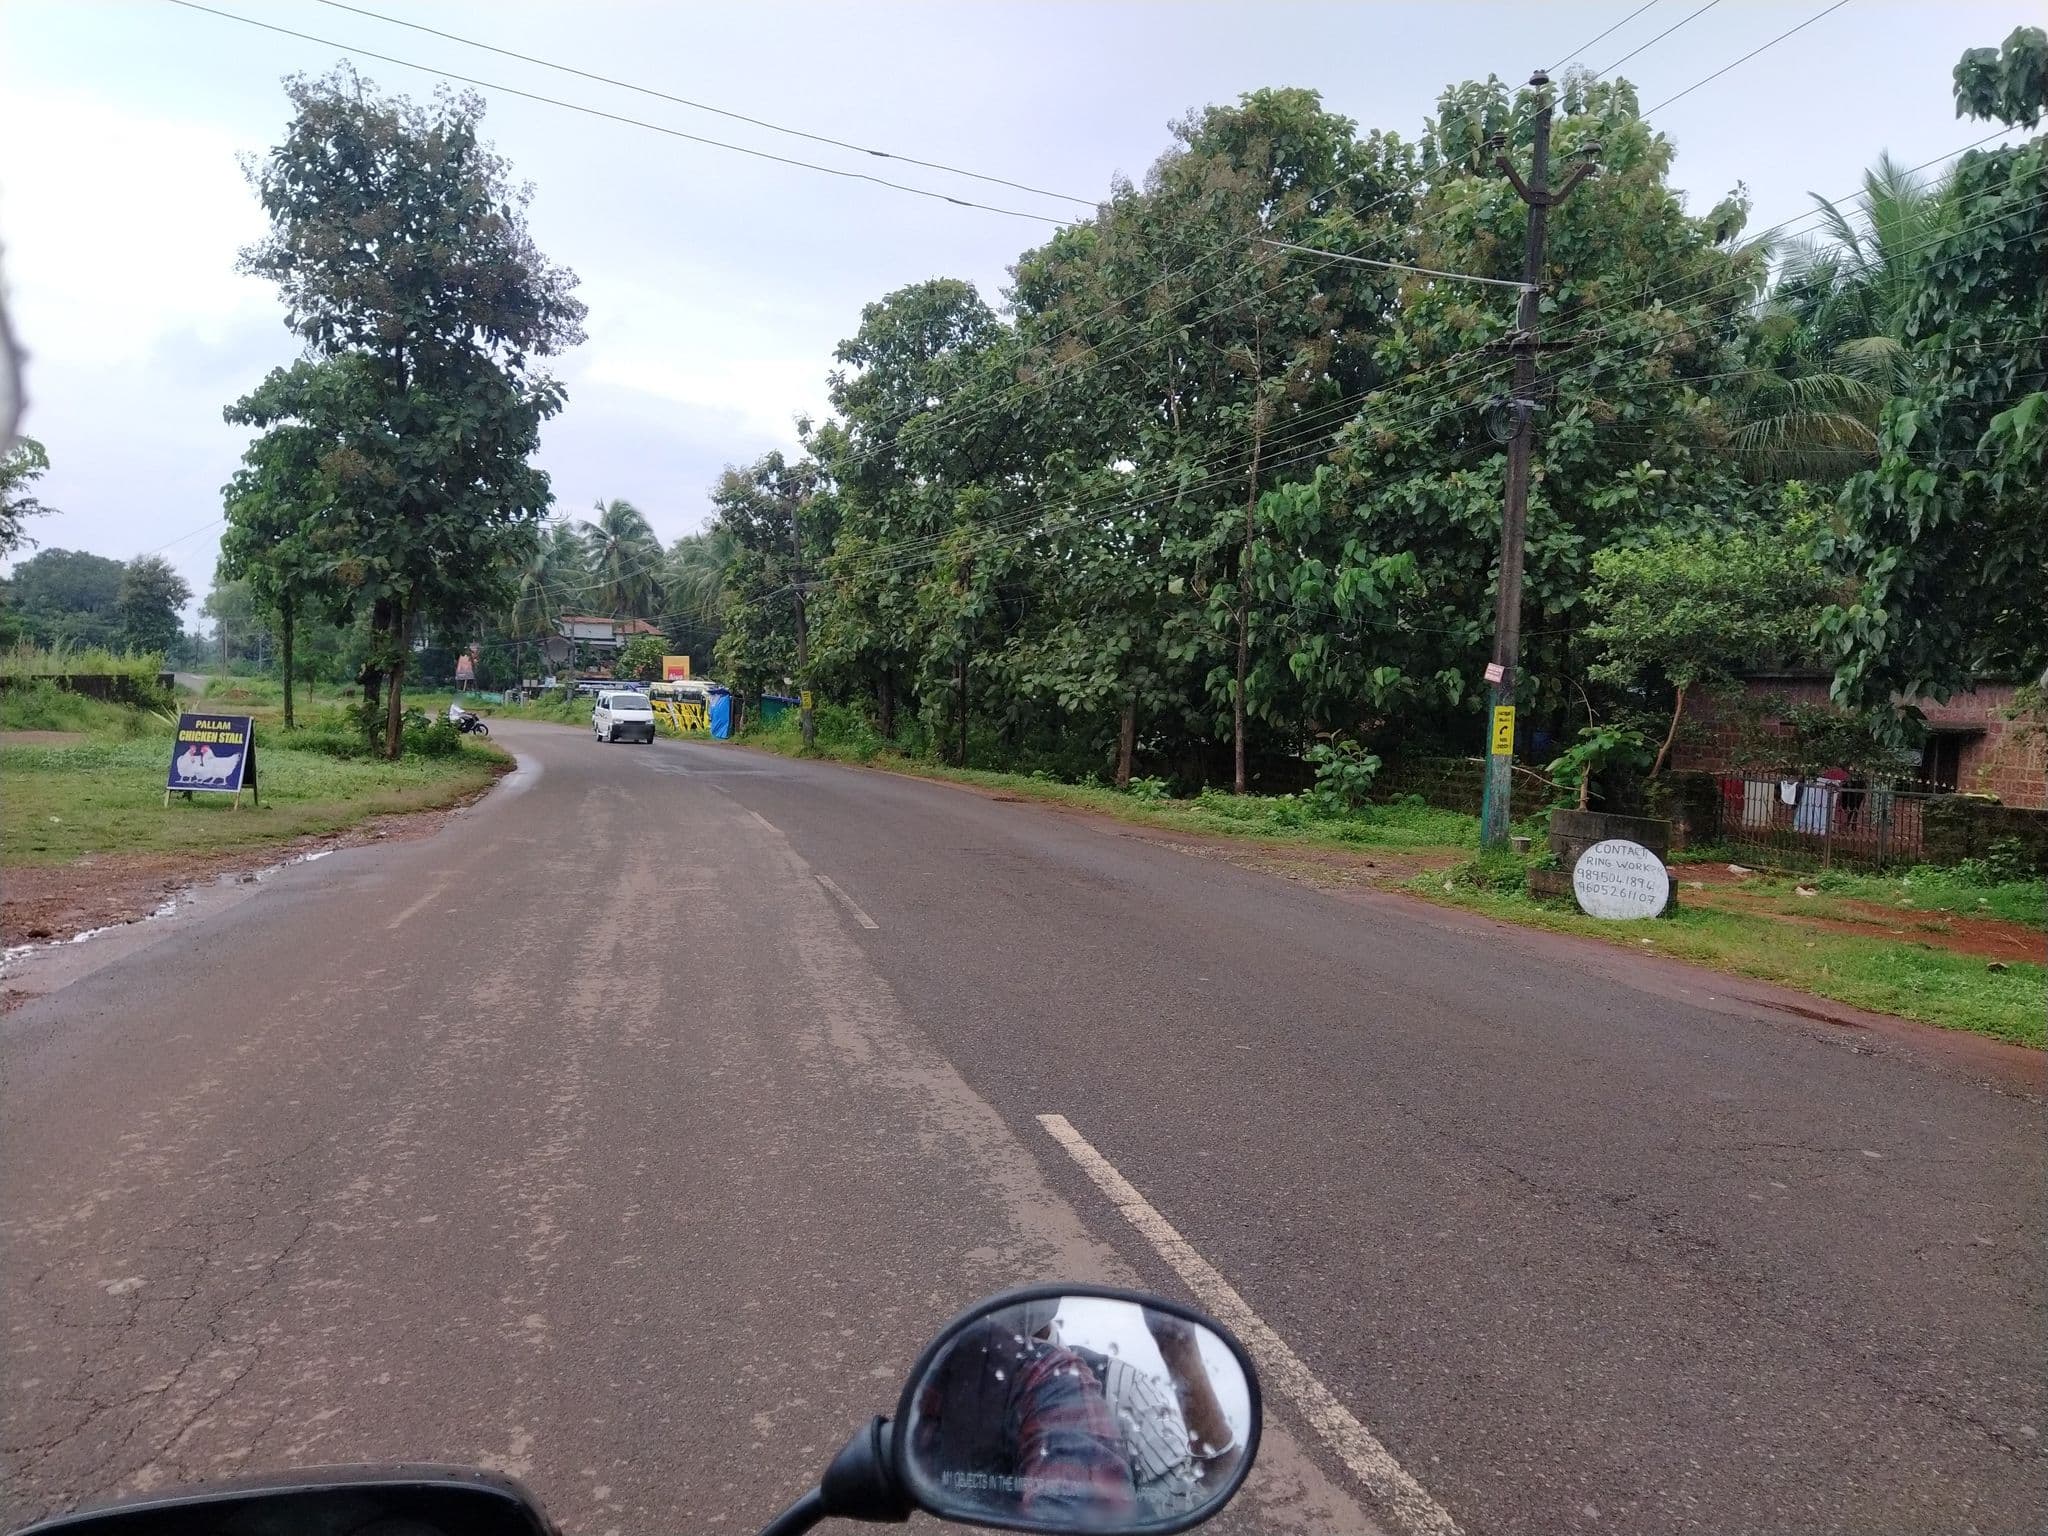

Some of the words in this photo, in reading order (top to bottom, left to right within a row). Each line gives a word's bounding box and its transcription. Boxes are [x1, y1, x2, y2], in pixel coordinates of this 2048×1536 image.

[195, 720, 231, 729] PALLAM
[179, 730, 218, 743] CHICKEN
[218, 732, 243, 744] STALL
[1586, 856, 1611, 867] RING
